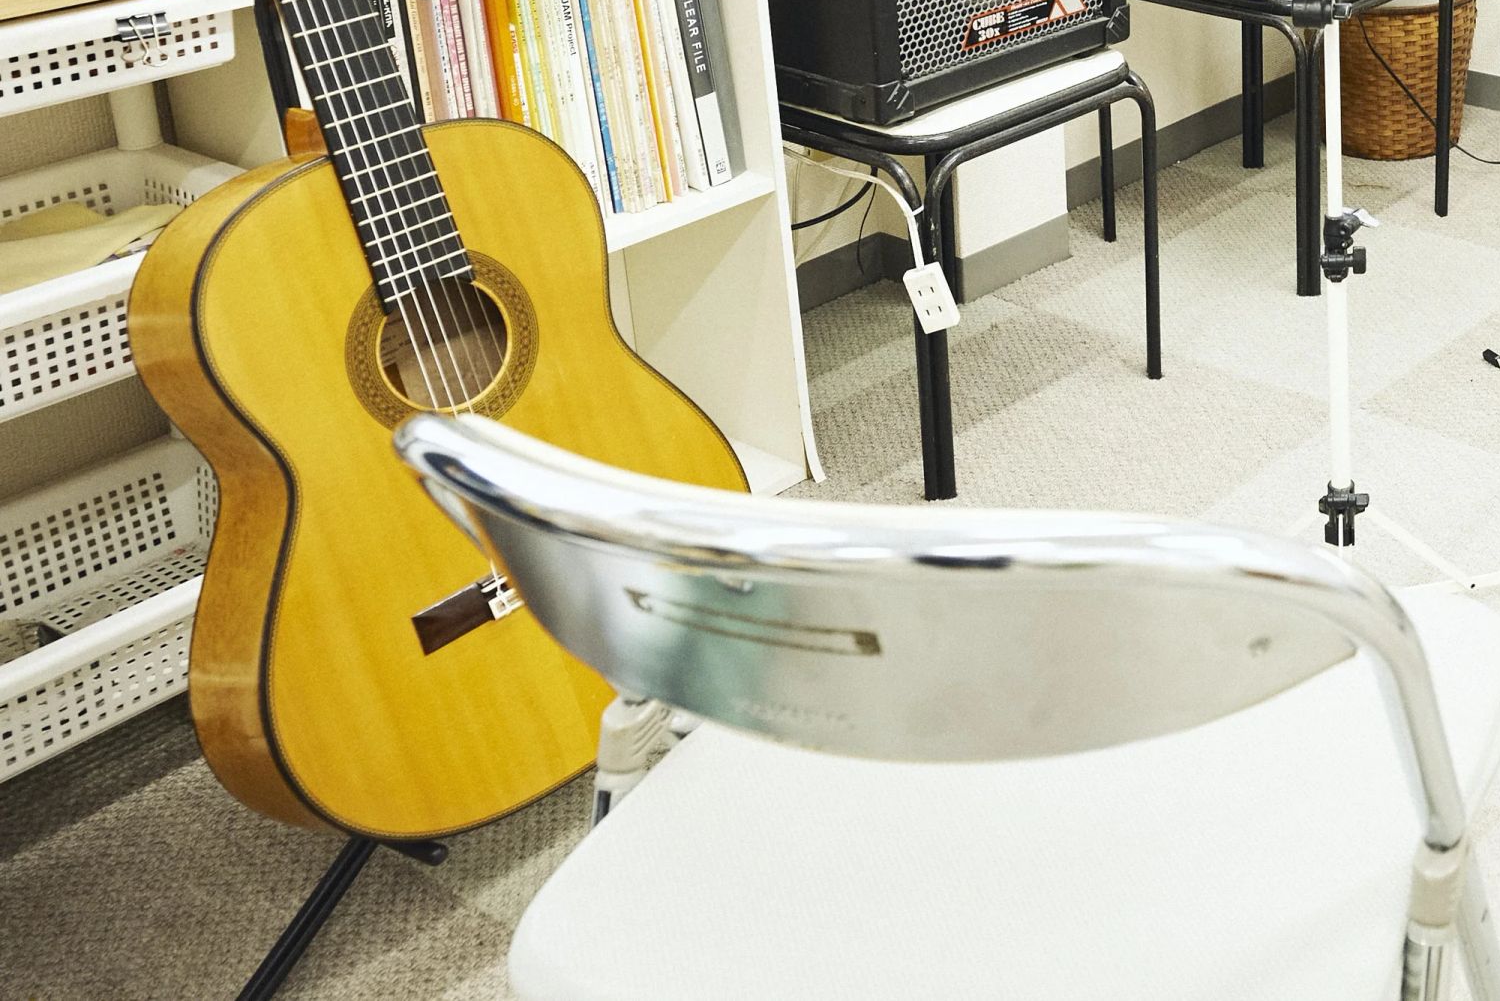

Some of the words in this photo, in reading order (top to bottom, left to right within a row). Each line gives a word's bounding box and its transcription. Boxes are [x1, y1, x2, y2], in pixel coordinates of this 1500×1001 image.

[972, 10, 1005, 31] CUBE
[978, 26, 1001, 41] 30x
[566, 23, 577, 55] Project
[692, 42, 707, 74] FILE
